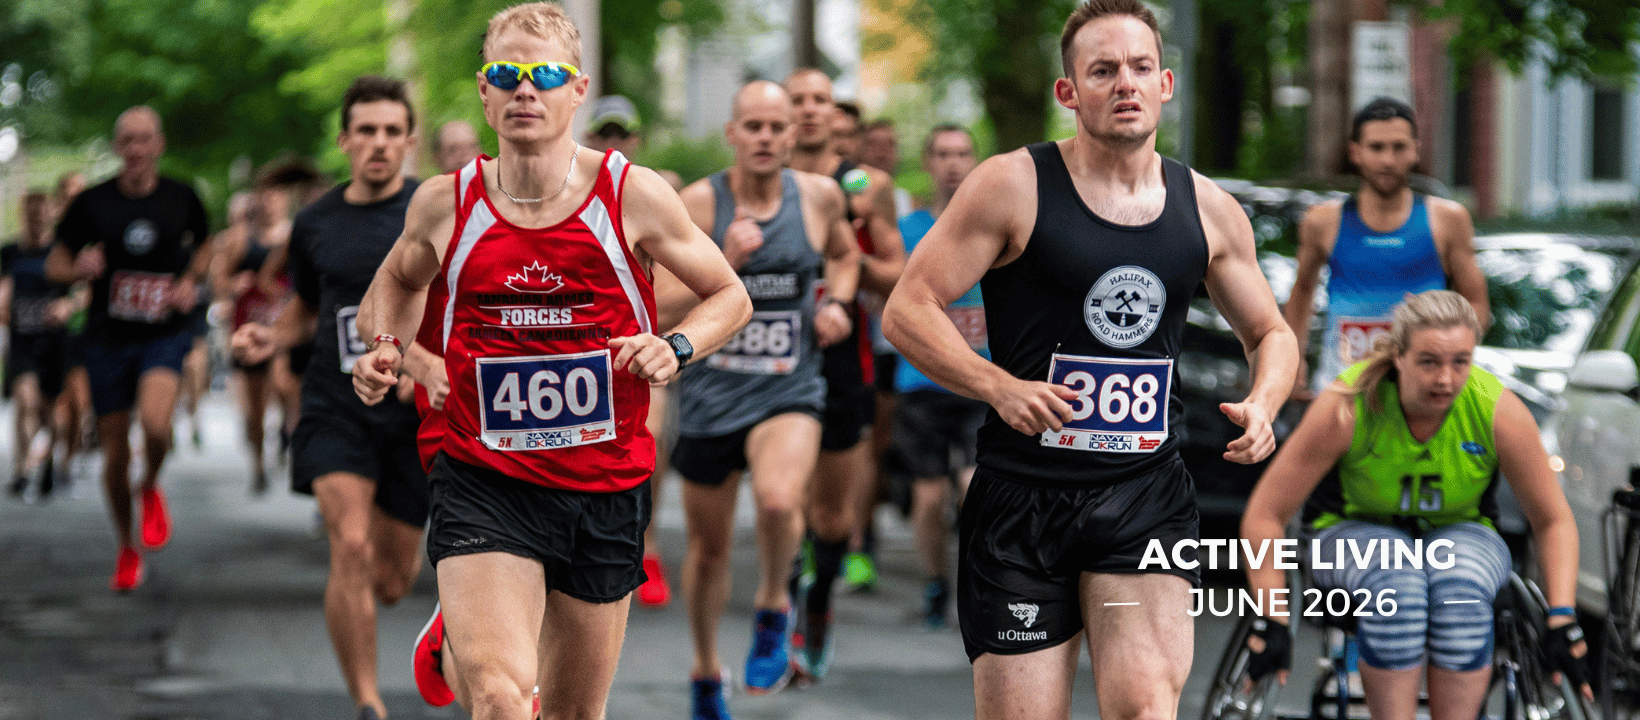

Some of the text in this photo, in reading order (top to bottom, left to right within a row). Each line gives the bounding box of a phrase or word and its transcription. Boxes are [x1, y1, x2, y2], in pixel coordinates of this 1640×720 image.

[1109, 273, 1153, 289] HALIFAX
[500, 307, 573, 326] FORCES
[1091, 312, 1154, 341] ROAD HAMMERS
[492, 367, 599, 421] 460
[1062, 370, 1159, 424] 368
[498, 437, 512, 448] 5K
[526, 432, 561, 440] NAVY
[1058, 434, 1077, 446] 5K
[1400, 474, 1442, 511] 15
